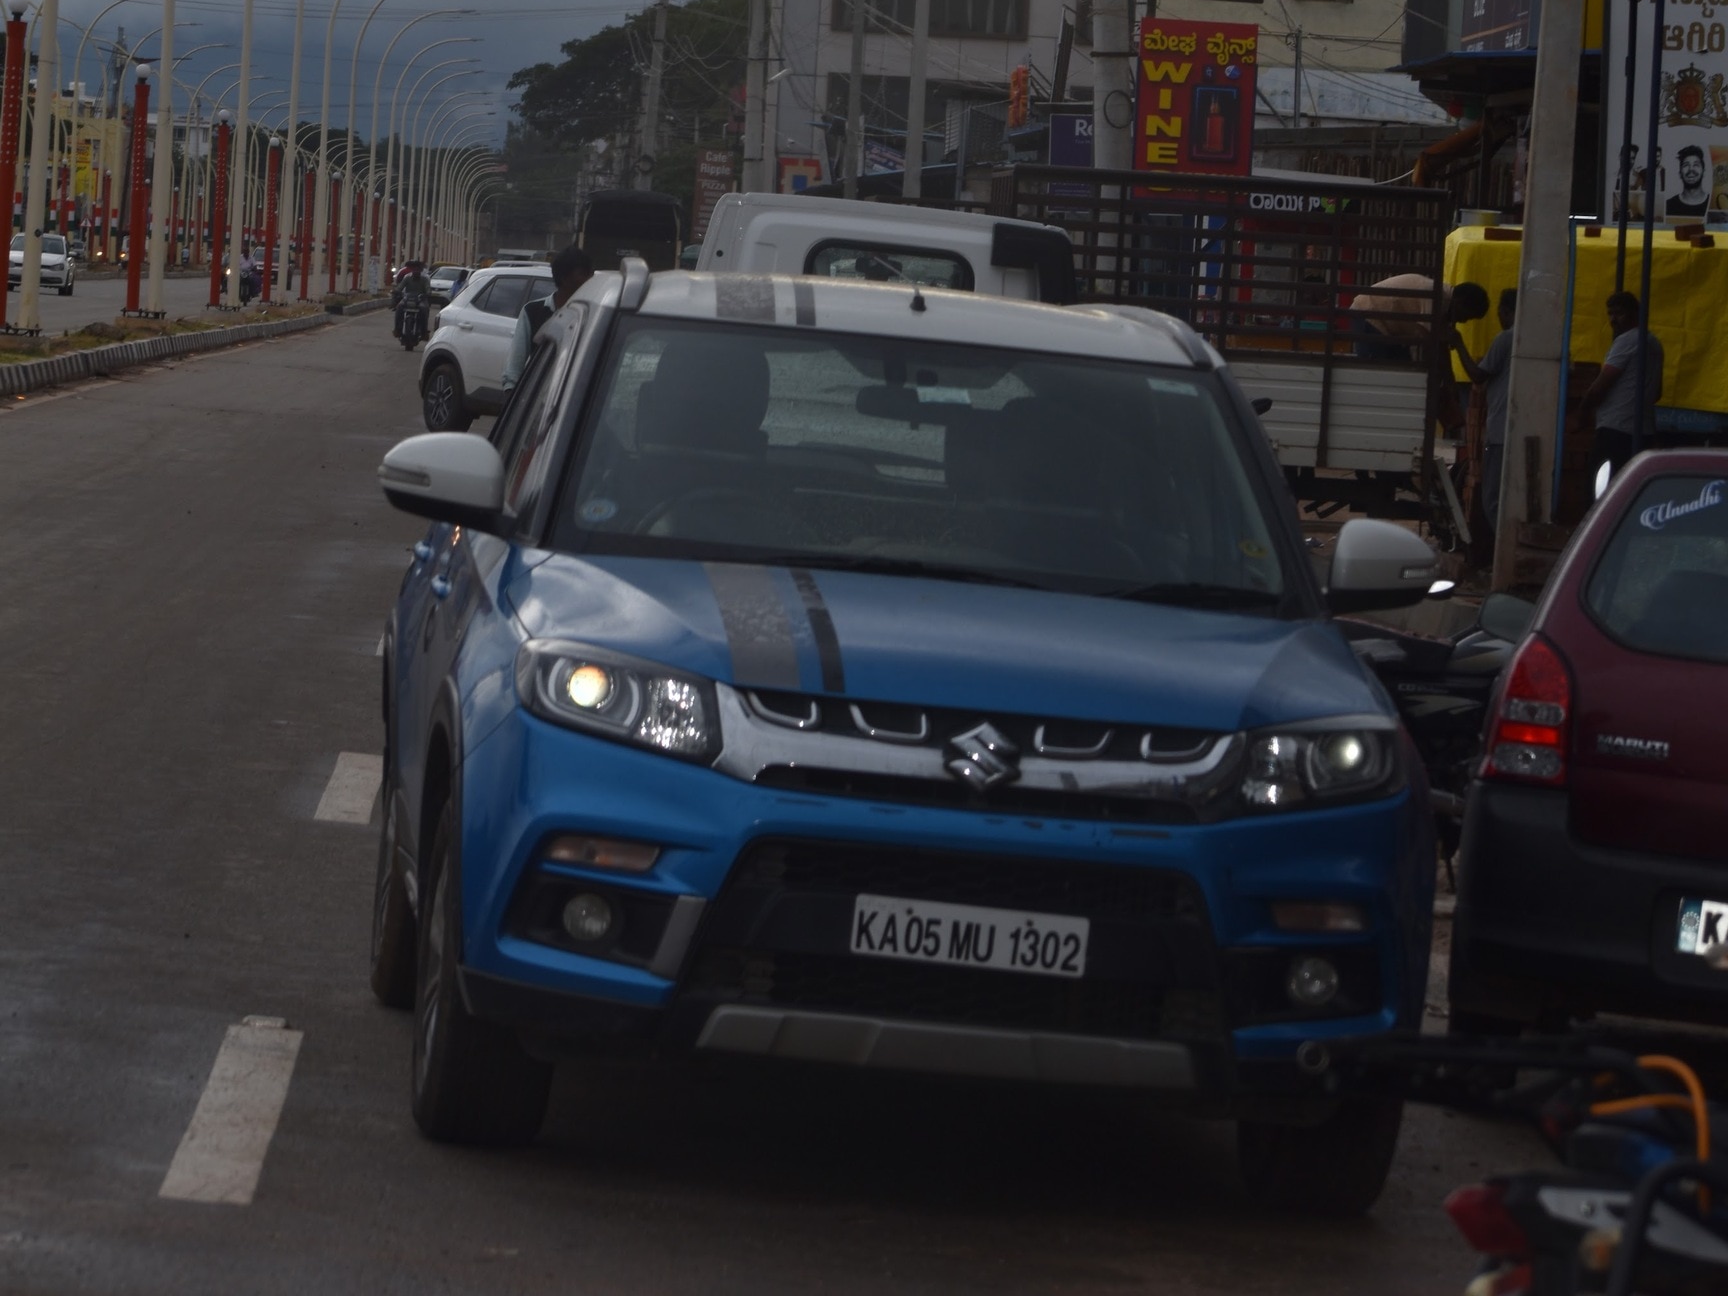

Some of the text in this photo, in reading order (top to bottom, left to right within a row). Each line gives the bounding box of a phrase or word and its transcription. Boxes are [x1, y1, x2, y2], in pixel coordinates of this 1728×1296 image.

[1142, 60, 1193, 192] WINE
[948, 920, 996, 963] MU
[1009, 926, 1082, 972] 1302
